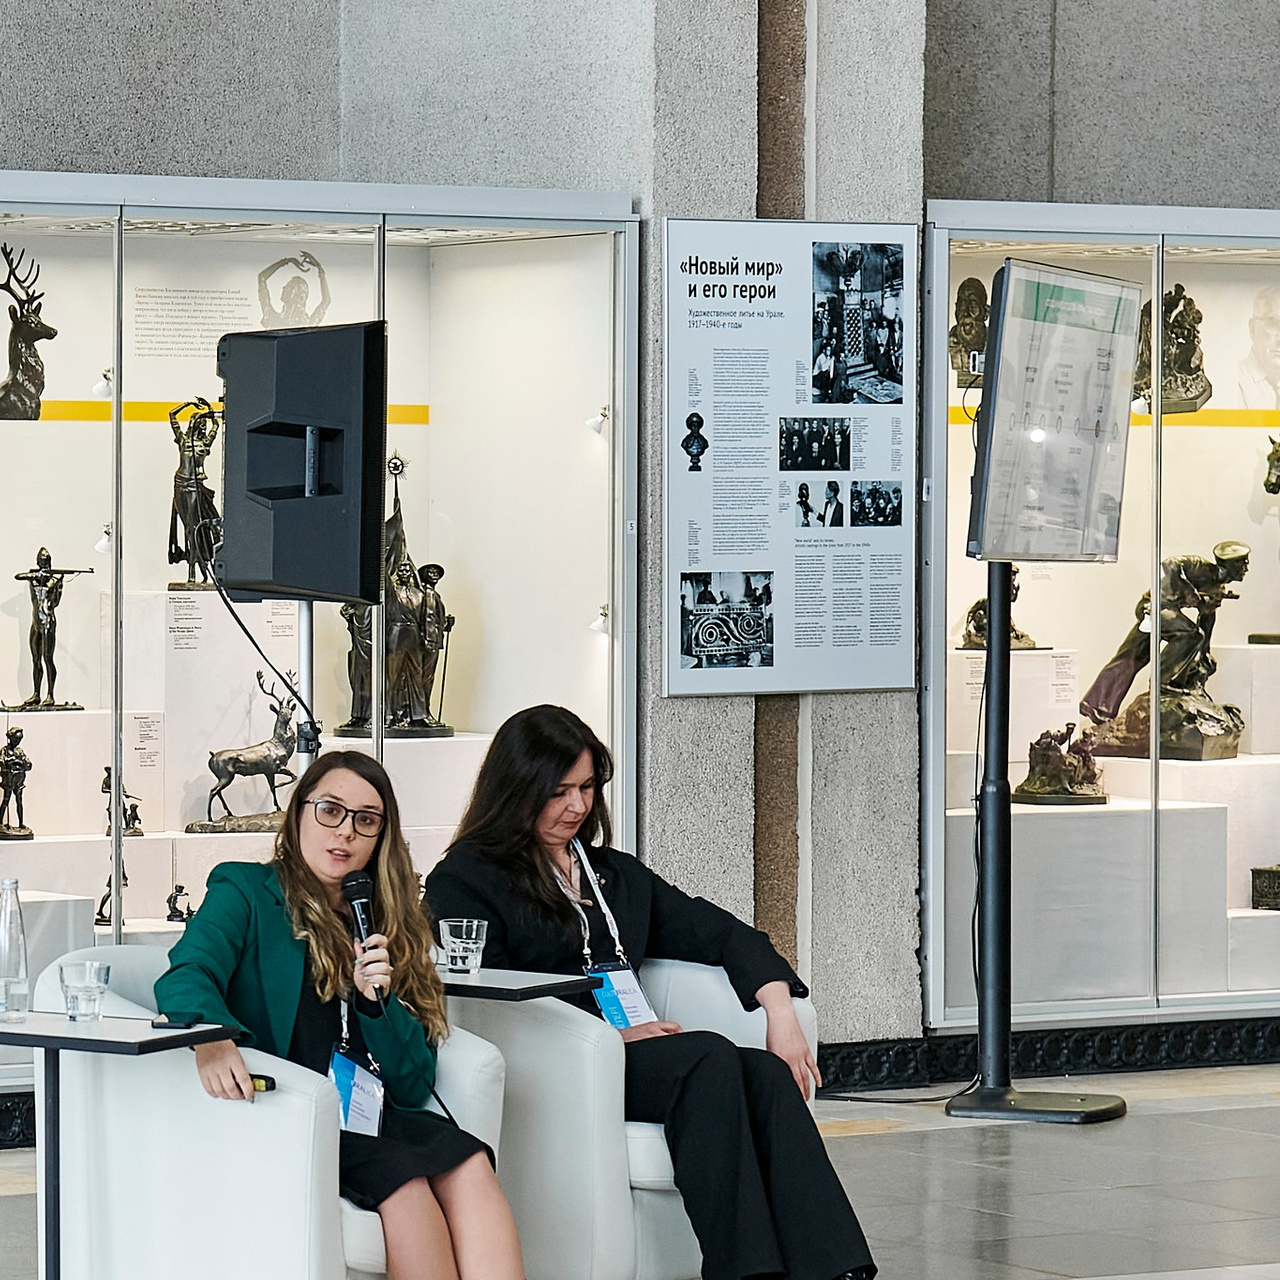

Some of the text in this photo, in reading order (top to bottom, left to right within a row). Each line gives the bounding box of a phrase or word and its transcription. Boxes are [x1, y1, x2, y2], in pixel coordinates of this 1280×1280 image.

[680, 256, 783, 281] «Новый мир»
[688, 283, 776, 303] и его герои
[688, 308, 737, 319] Художественное
[756, 310, 765, 318] на
[629, 522, 634, 531] 5
